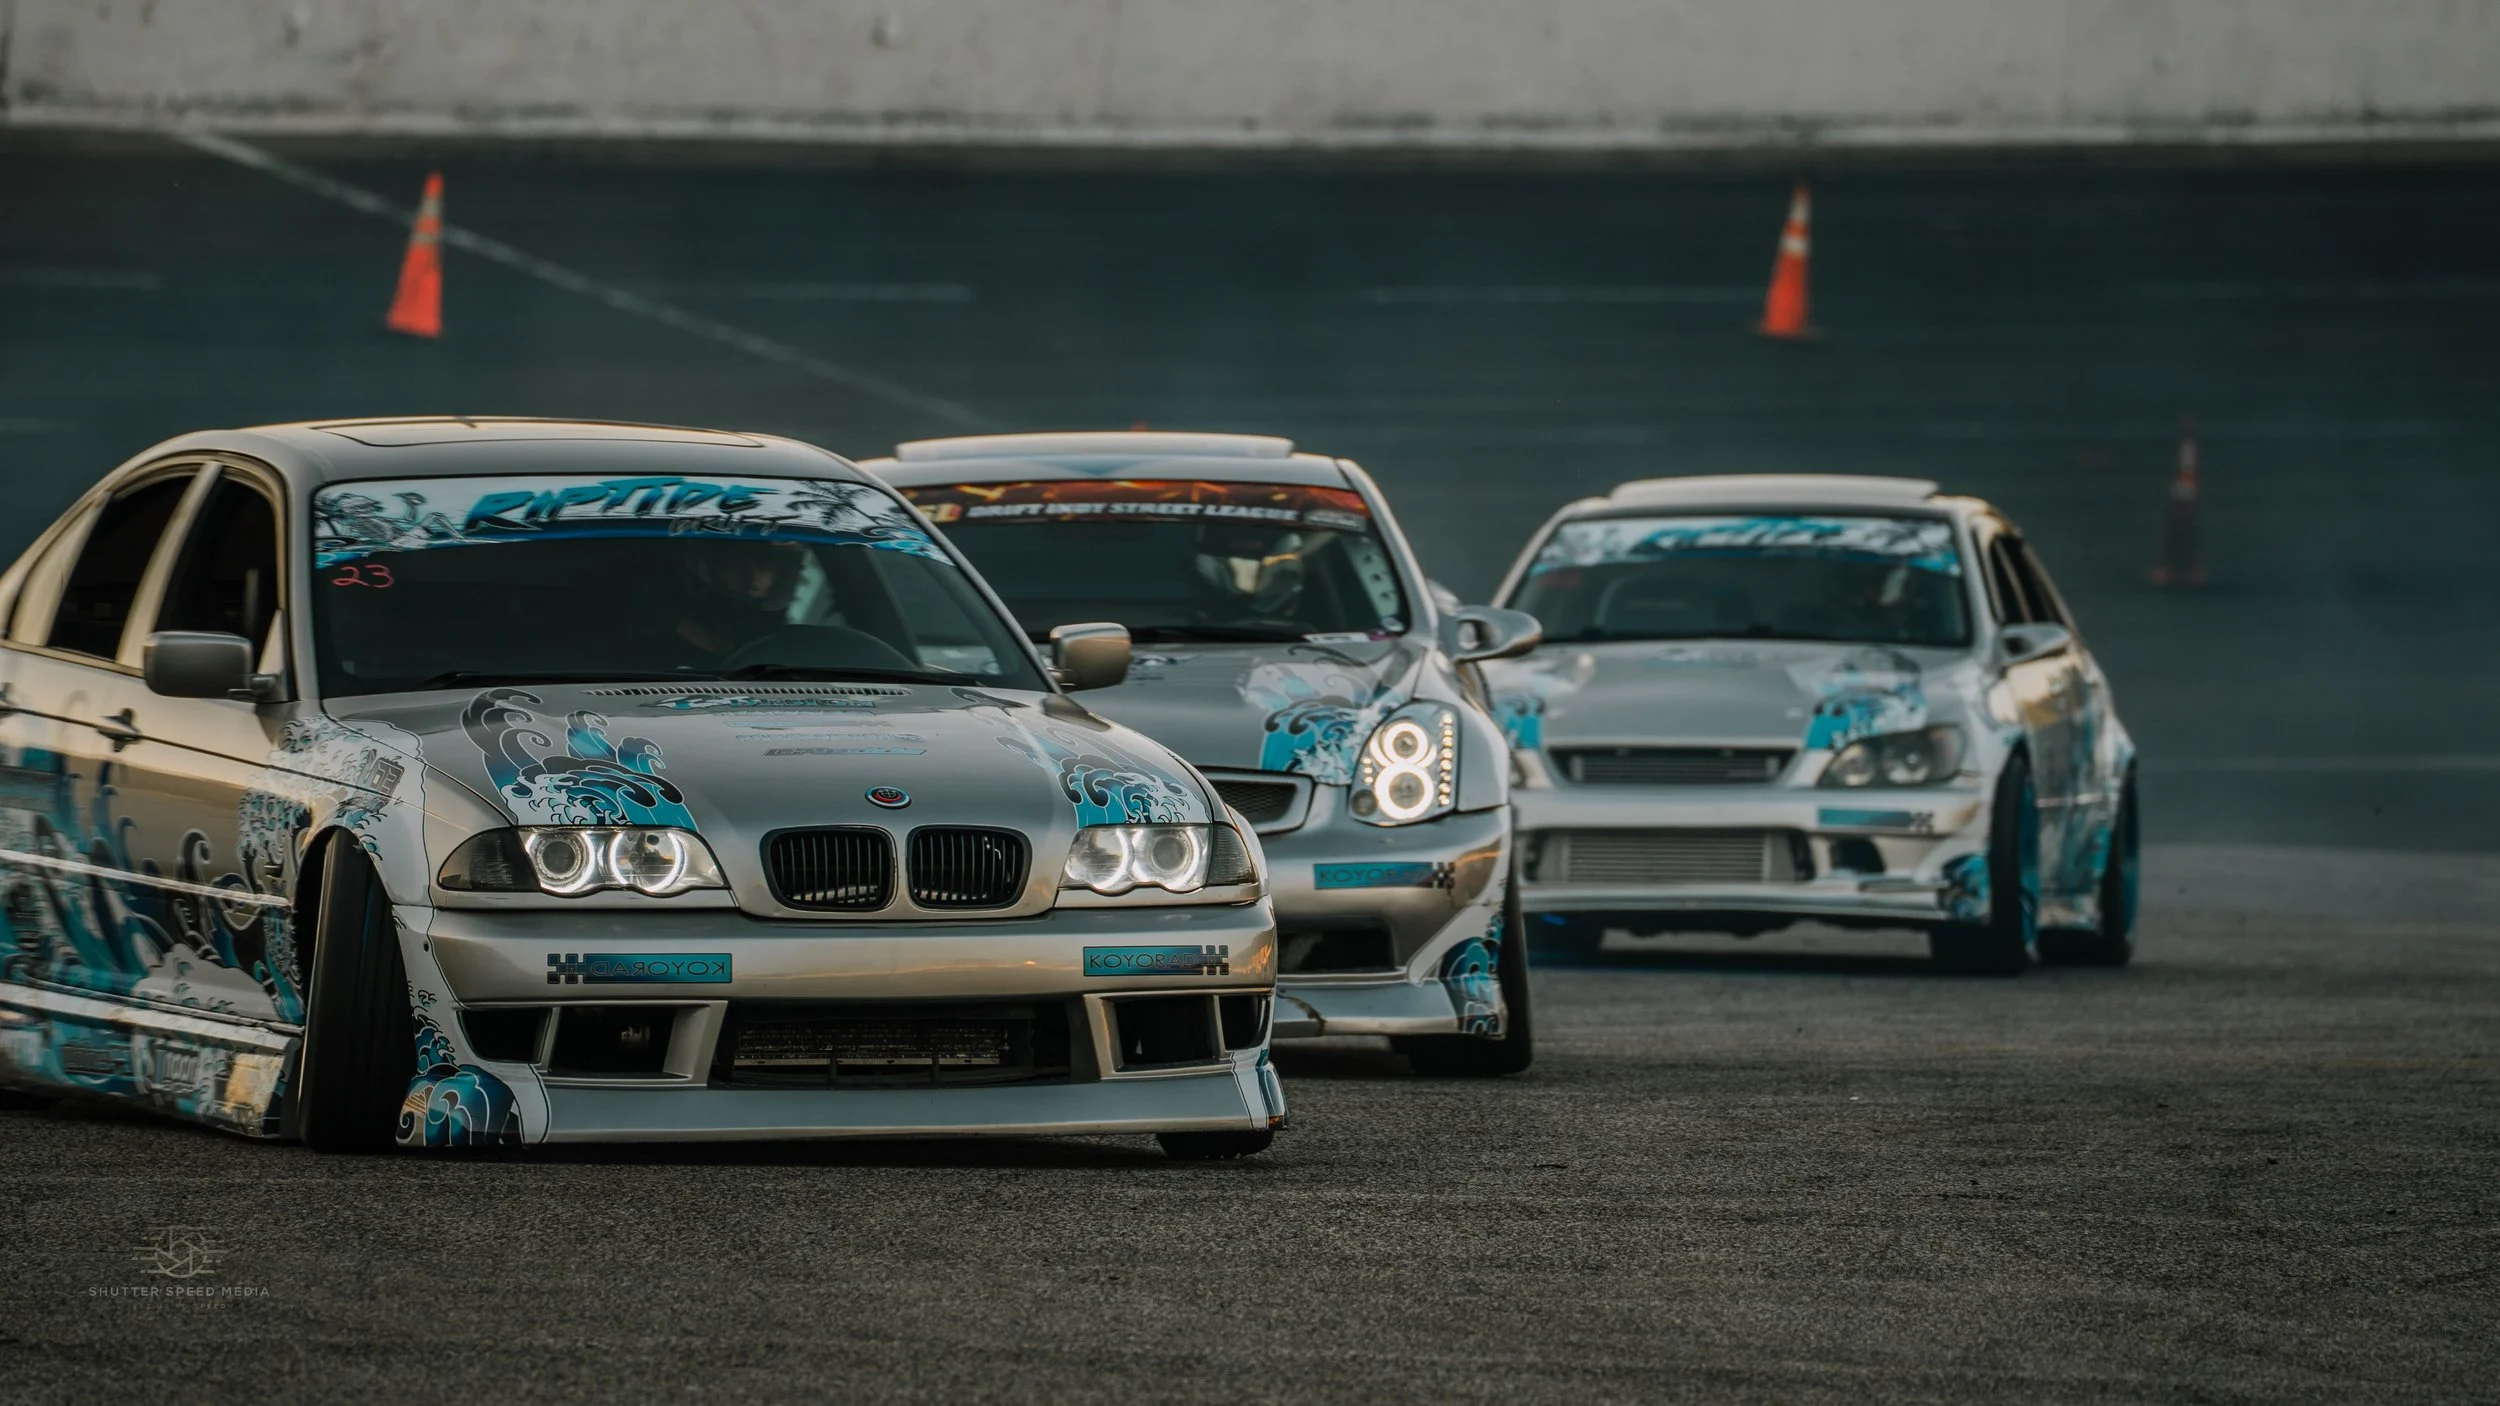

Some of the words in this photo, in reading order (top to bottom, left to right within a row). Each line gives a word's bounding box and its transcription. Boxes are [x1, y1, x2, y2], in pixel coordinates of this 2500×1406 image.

[464, 477, 782, 532] RIPTIDE
[967, 504, 1045, 517] DRIFT
[1107, 503, 1203, 515] STREET
[1203, 504, 1299, 520] LEAGUE
[669, 513, 800, 536] DRIFT
[331, 564, 395, 590] 23
[1089, 953, 1198, 968] KOYORAD
